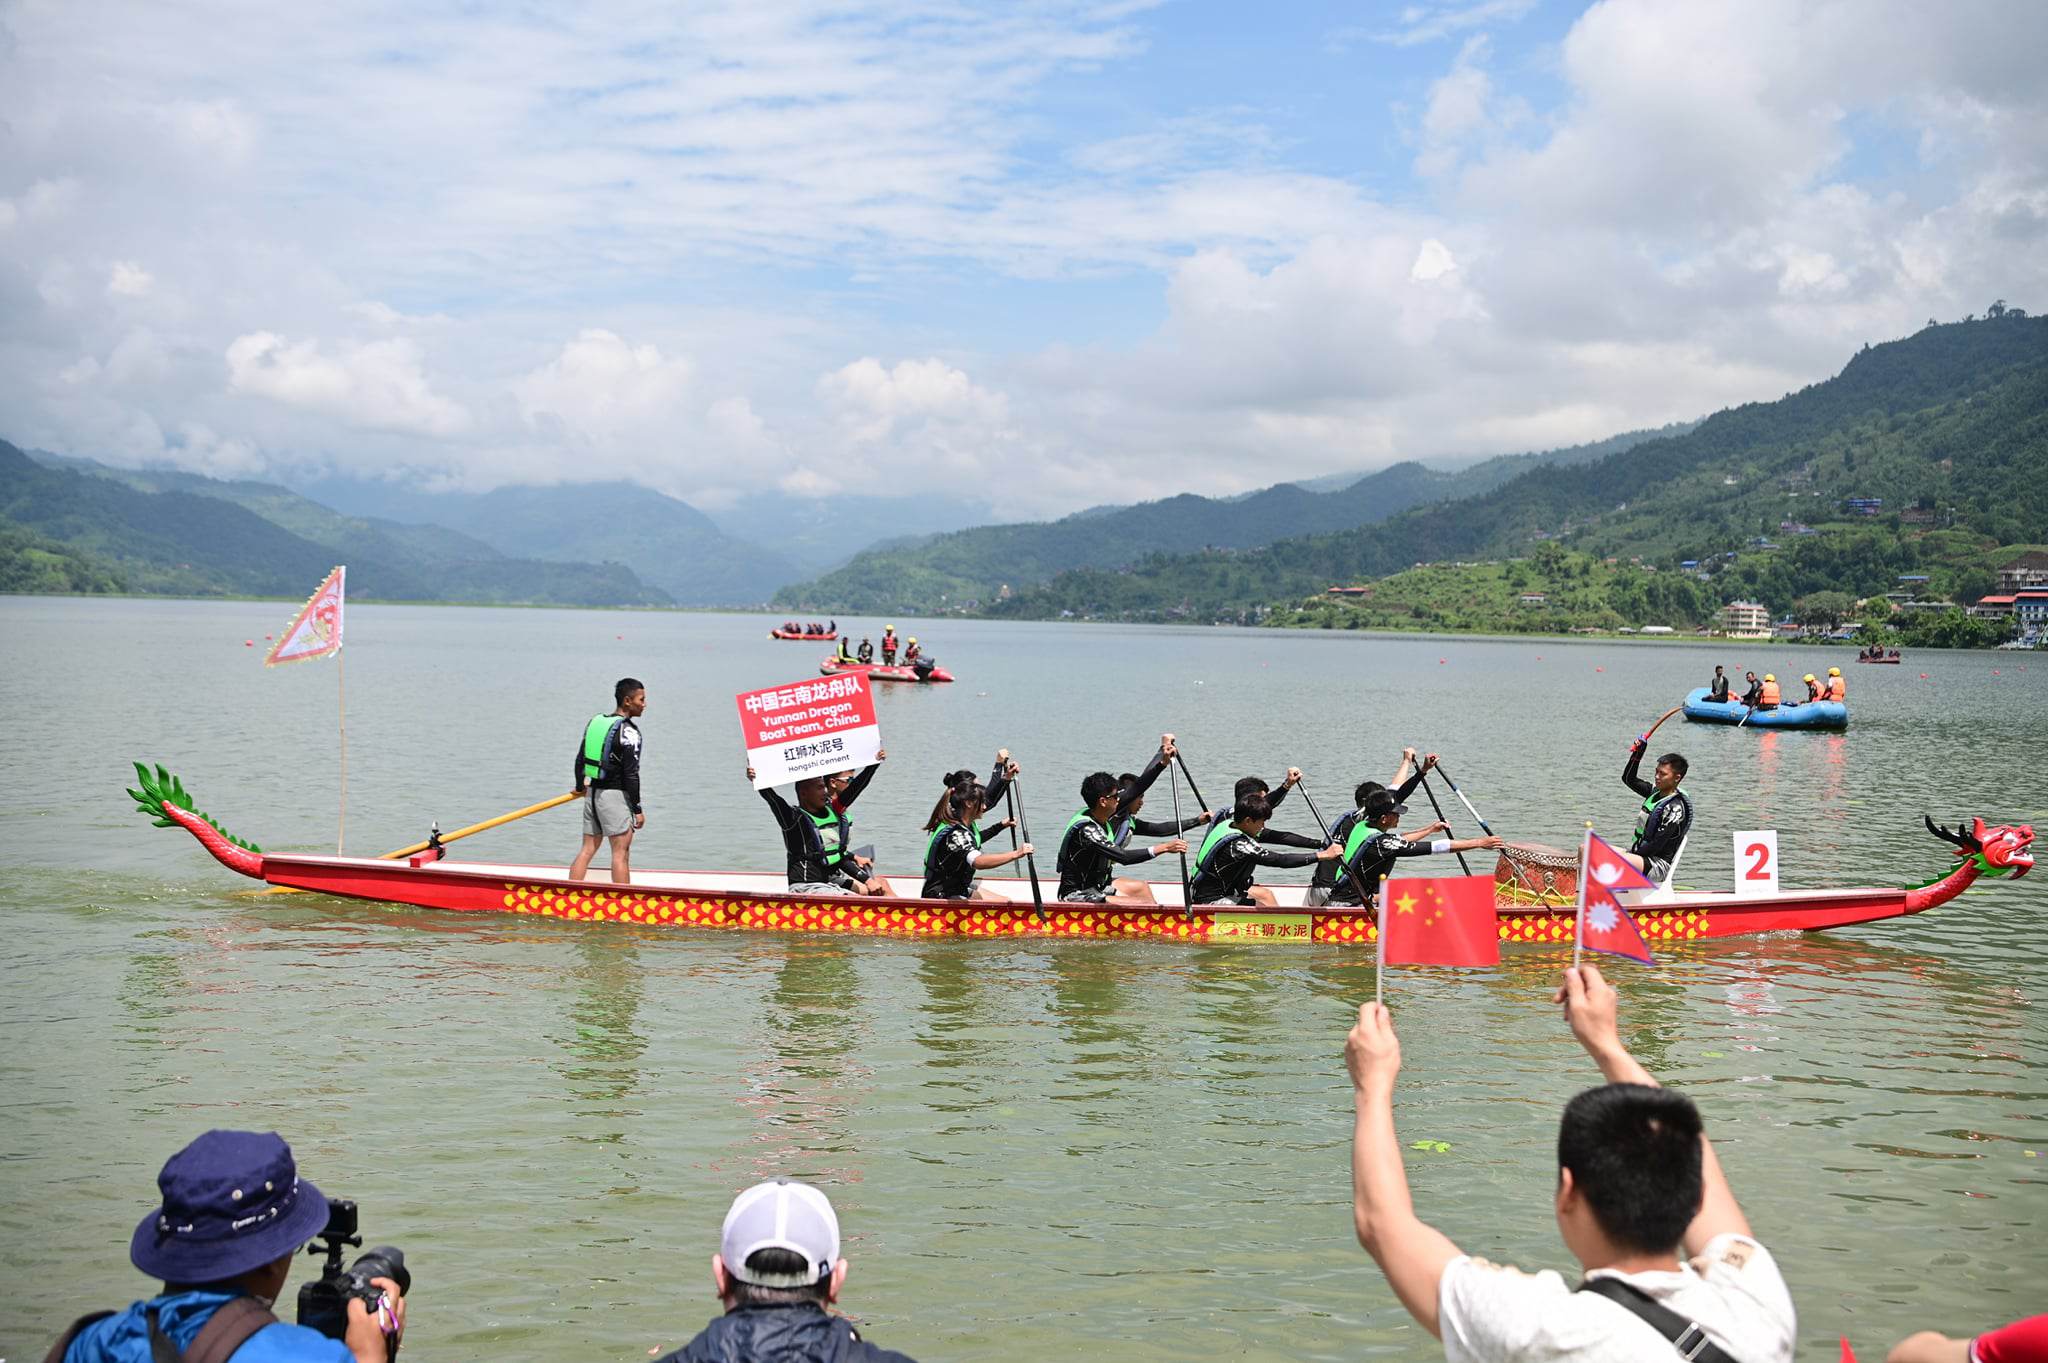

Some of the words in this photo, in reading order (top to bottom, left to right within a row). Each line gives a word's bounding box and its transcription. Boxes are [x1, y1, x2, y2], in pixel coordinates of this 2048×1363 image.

[745, 676, 863, 714] 中国云南龙舟队
[762, 711, 808, 727] Yunnan
[809, 702, 853, 718] Dragon
[759, 728, 787, 742] Boat
[788, 721, 824, 736] Team,
[825, 713, 861, 729] China
[784, 737, 844, 762] 红狮水泥号
[788, 761, 819, 774] Hongshi
[819, 754, 850, 766] Cement
[1745, 843, 1770, 880] 2
[1246, 923, 1308, 937] 红狮水泥
